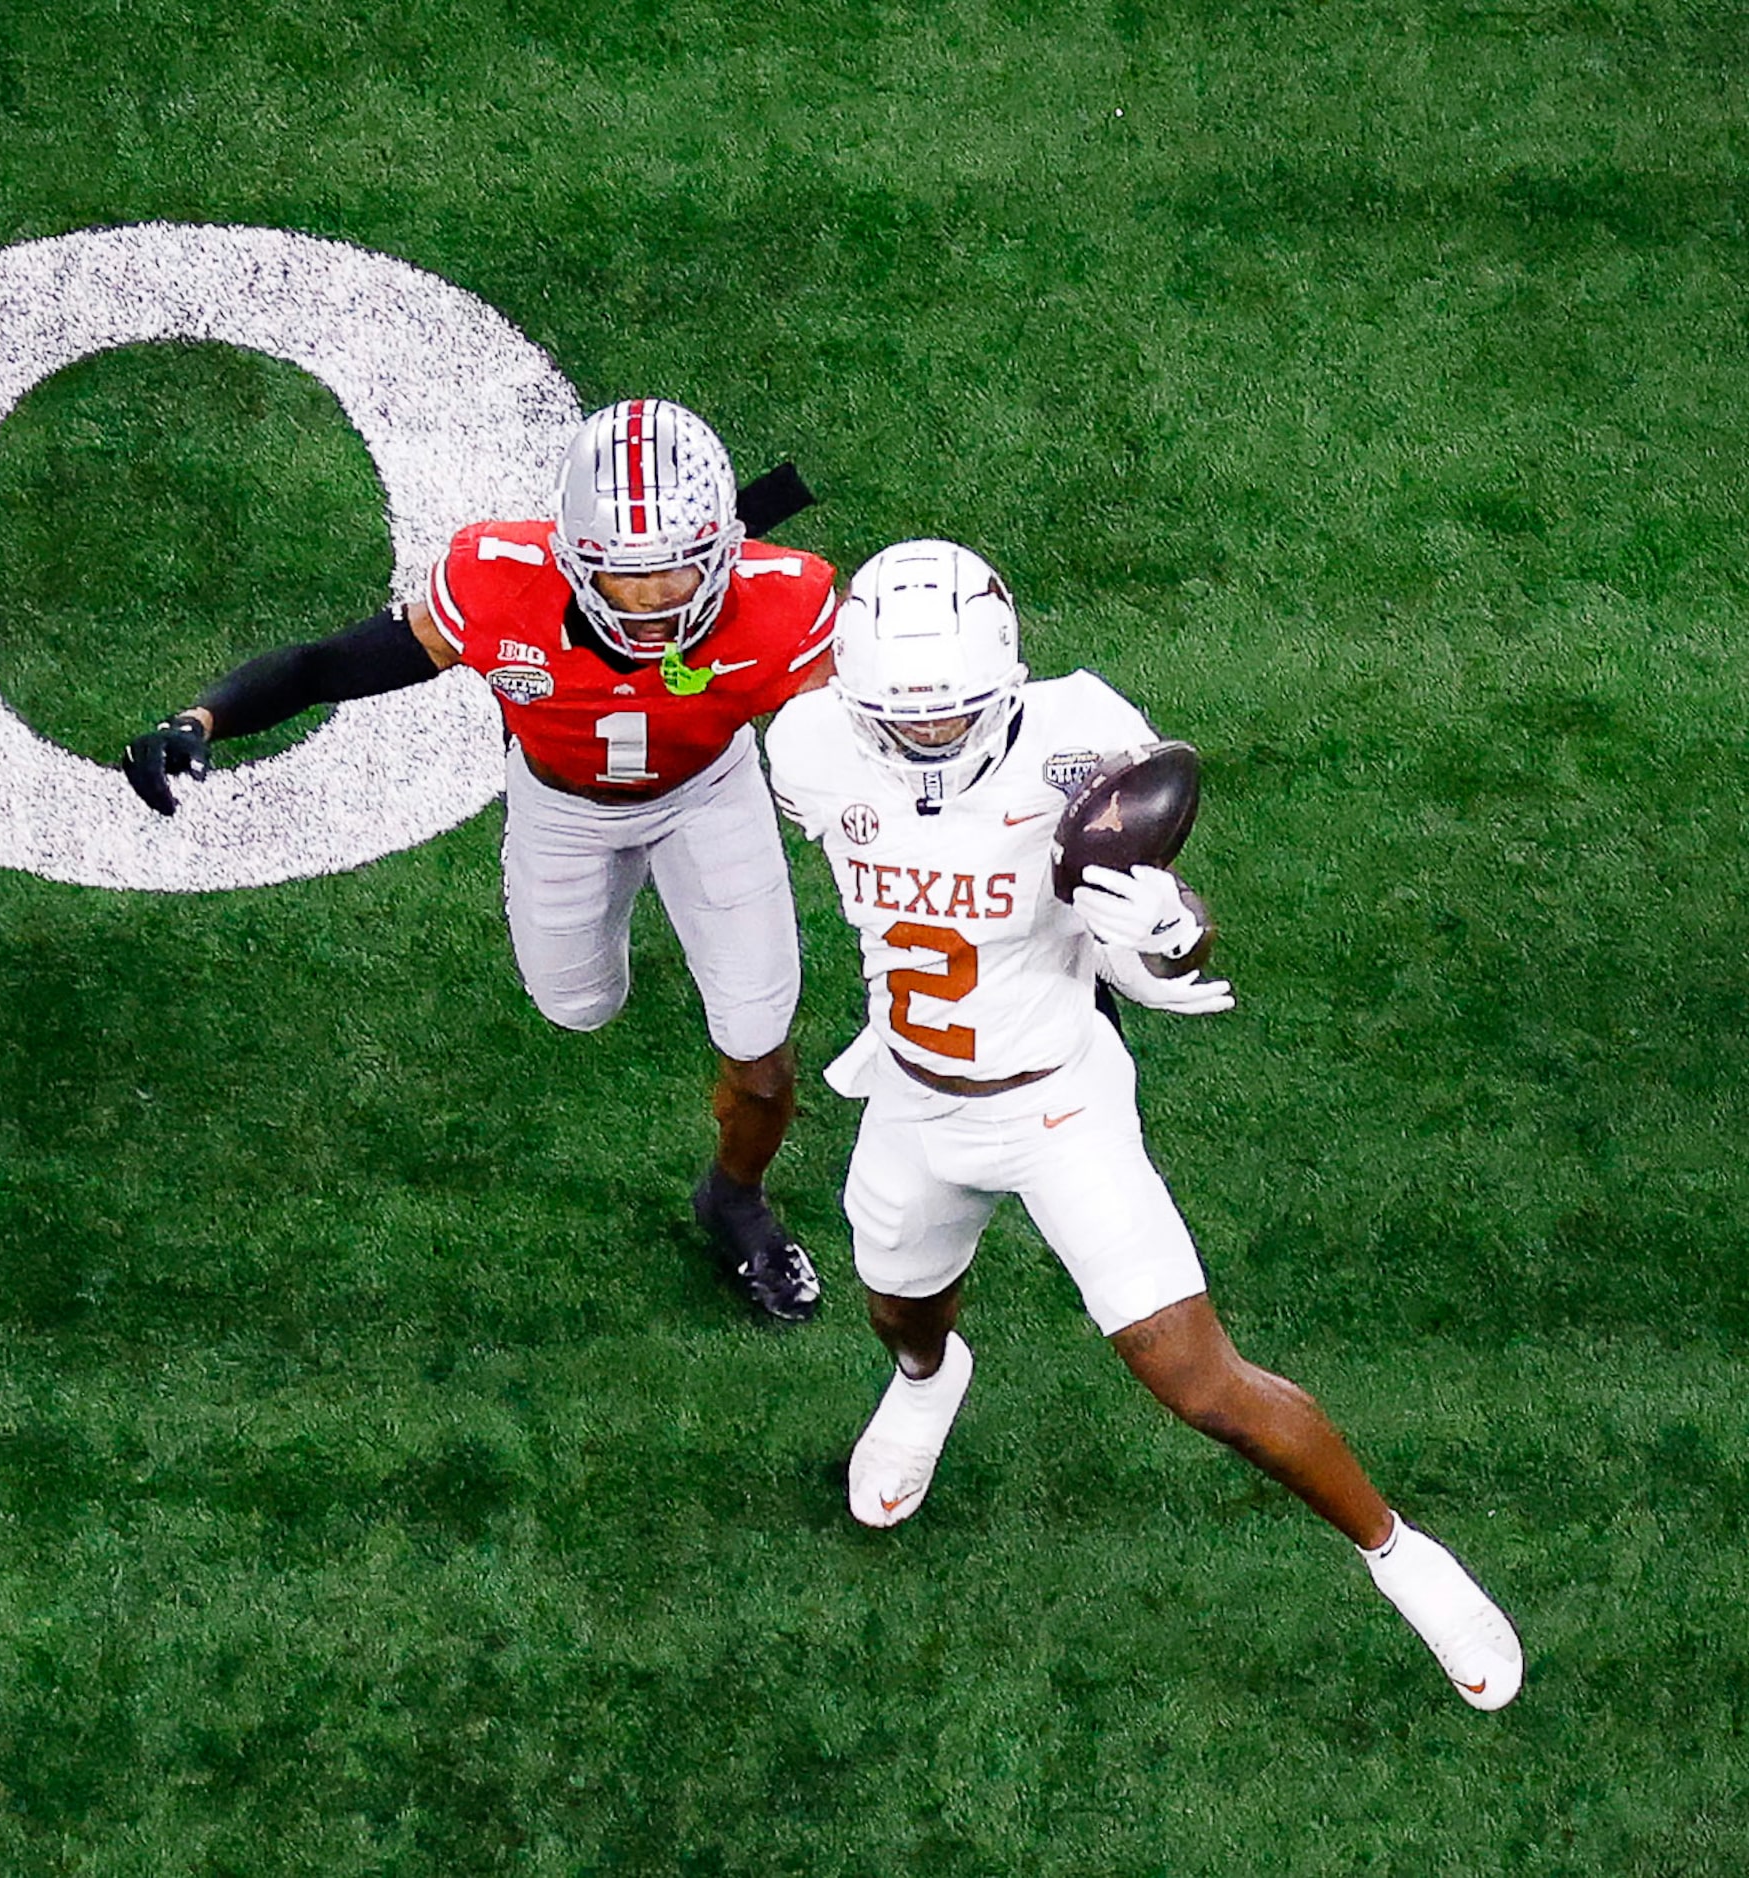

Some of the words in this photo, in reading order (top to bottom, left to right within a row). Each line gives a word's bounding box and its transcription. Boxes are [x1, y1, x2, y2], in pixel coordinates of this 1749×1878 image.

[478, 536, 545, 566] 1
[734, 557, 803, 579] 1
[595, 711, 659, 783] 1
[841, 804, 879, 845] SEC
[847, 858, 1016, 919] TEXAS
[882, 920, 978, 1062] 2
